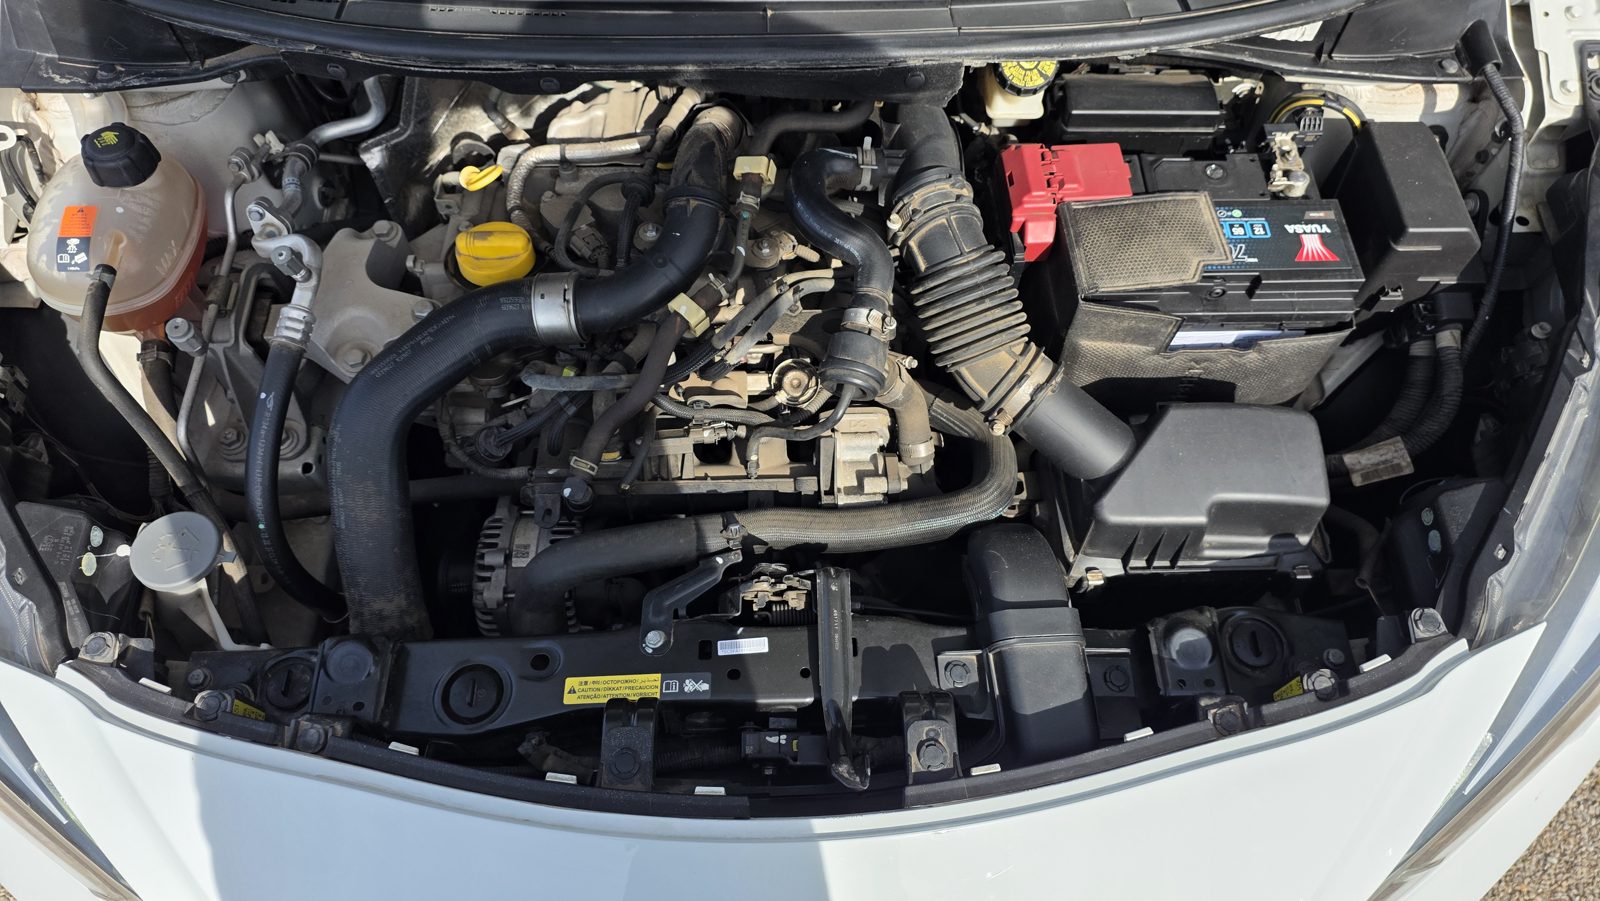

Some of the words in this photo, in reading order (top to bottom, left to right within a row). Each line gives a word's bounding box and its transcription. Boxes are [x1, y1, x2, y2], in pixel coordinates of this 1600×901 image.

[1231, 227, 1245, 235] 65
[1253, 227, 1265, 235] 12
[1284, 223, 1331, 233] YUASA
